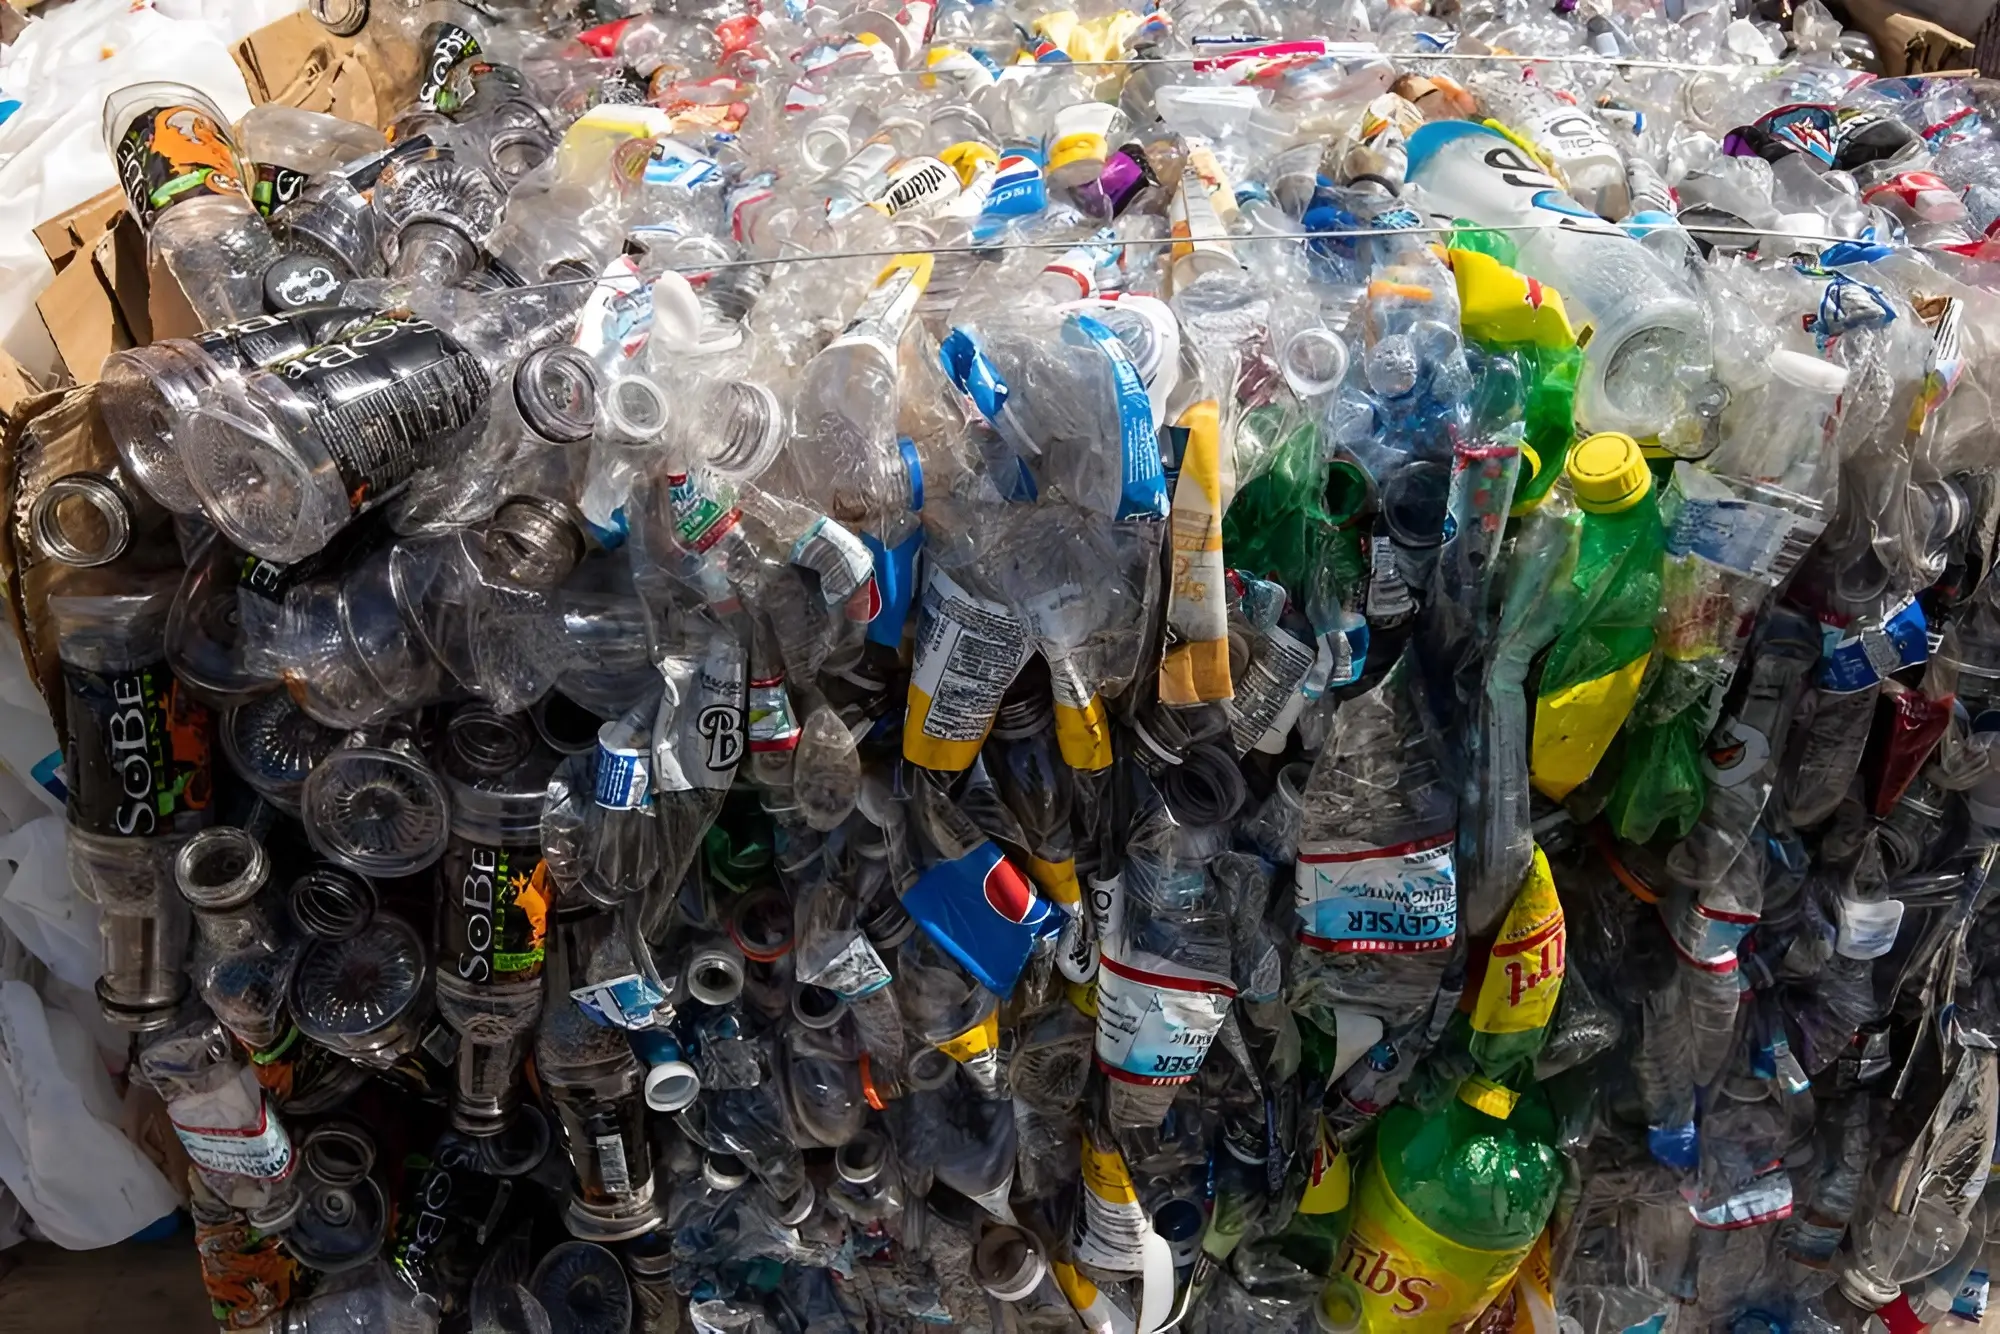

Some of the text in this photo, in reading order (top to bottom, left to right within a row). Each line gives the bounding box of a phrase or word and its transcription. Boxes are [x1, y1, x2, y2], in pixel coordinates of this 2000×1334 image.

[420, 27, 471, 111] SOBE
[982, 185, 1033, 209] epsi
[283, 318, 437, 380] SOBE
[110, 676, 155, 834] SOBE
[459, 848, 495, 981] SOBE
[1348, 911, 1440, 937] GEYSER
